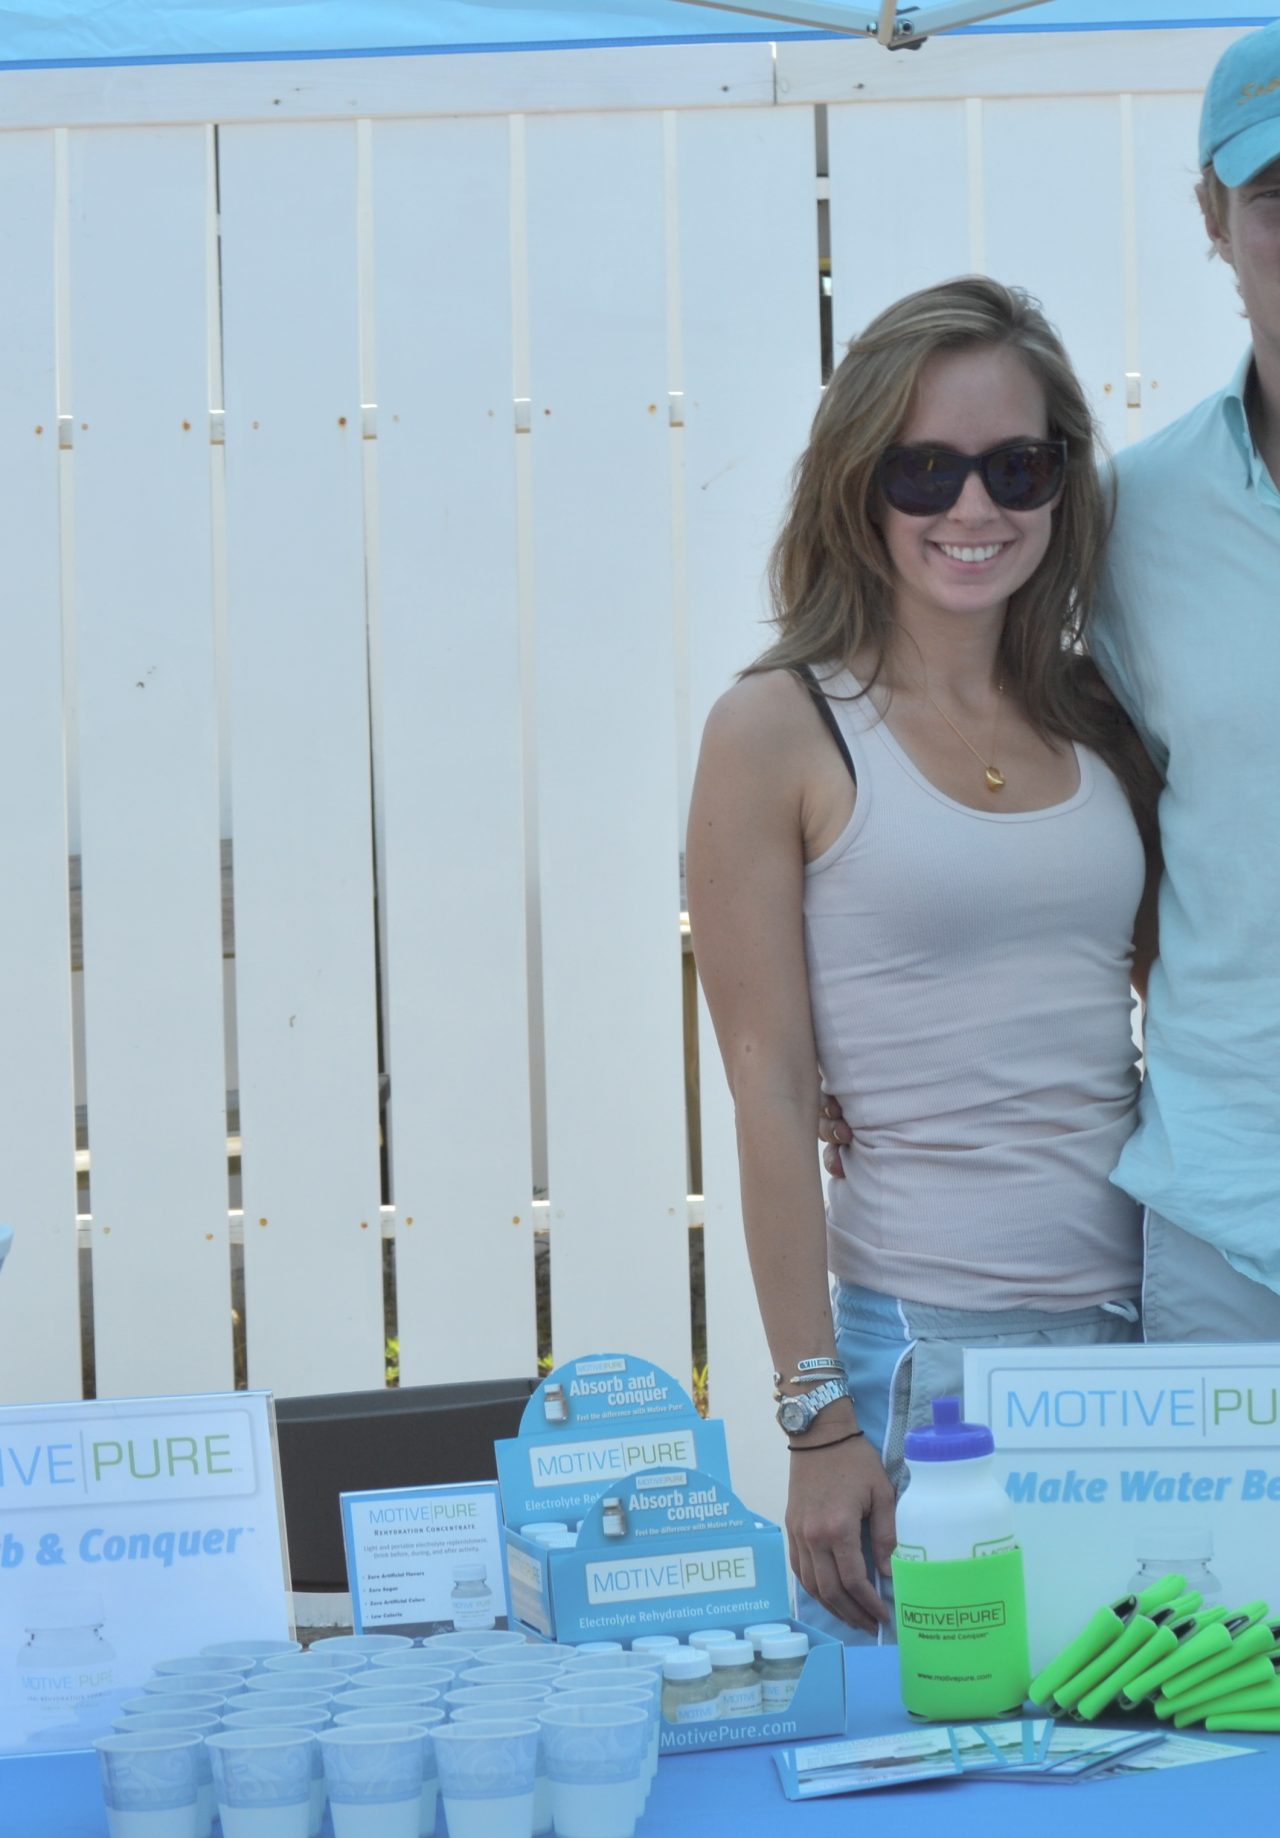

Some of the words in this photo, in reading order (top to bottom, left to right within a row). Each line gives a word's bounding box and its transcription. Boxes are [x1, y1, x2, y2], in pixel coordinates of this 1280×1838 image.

[569, 1375, 623, 1397] Absorb
[628, 1371, 656, 1388] and
[607, 1386, 669, 1406] conquer
[1007, 1389, 1195, 1427] MOTIVE
[92, 1434, 234, 1482] PURE
[538, 1447, 621, 1477] MOTIVE
[627, 1440, 688, 1466] PURE
[628, 1489, 684, 1511] Absorb
[689, 1485, 717, 1503] and
[1005, 1469, 1109, 1503] Make
[1120, 1470, 1232, 1502] Water
[369, 1505, 430, 1524] MOTIVE
[433, 1502, 479, 1519] PURE
[524, 1497, 581, 1512] Electrolyte
[667, 1502, 730, 1521] conquer
[36, 1532, 67, 1566] &
[594, 1564, 680, 1593] MOTIVE
[685, 1558, 747, 1584] PURE
[579, 1613, 637, 1629] Electrolyte
[639, 1605, 705, 1622] Rehydration
[705, 1599, 771, 1615] Concentrate
[904, 1609, 955, 1625] MOTIVE
[960, 1607, 1001, 1624] PURE
[942, 1632, 956, 1640] and
[660, 1720, 797, 1747] MotivePure.com
